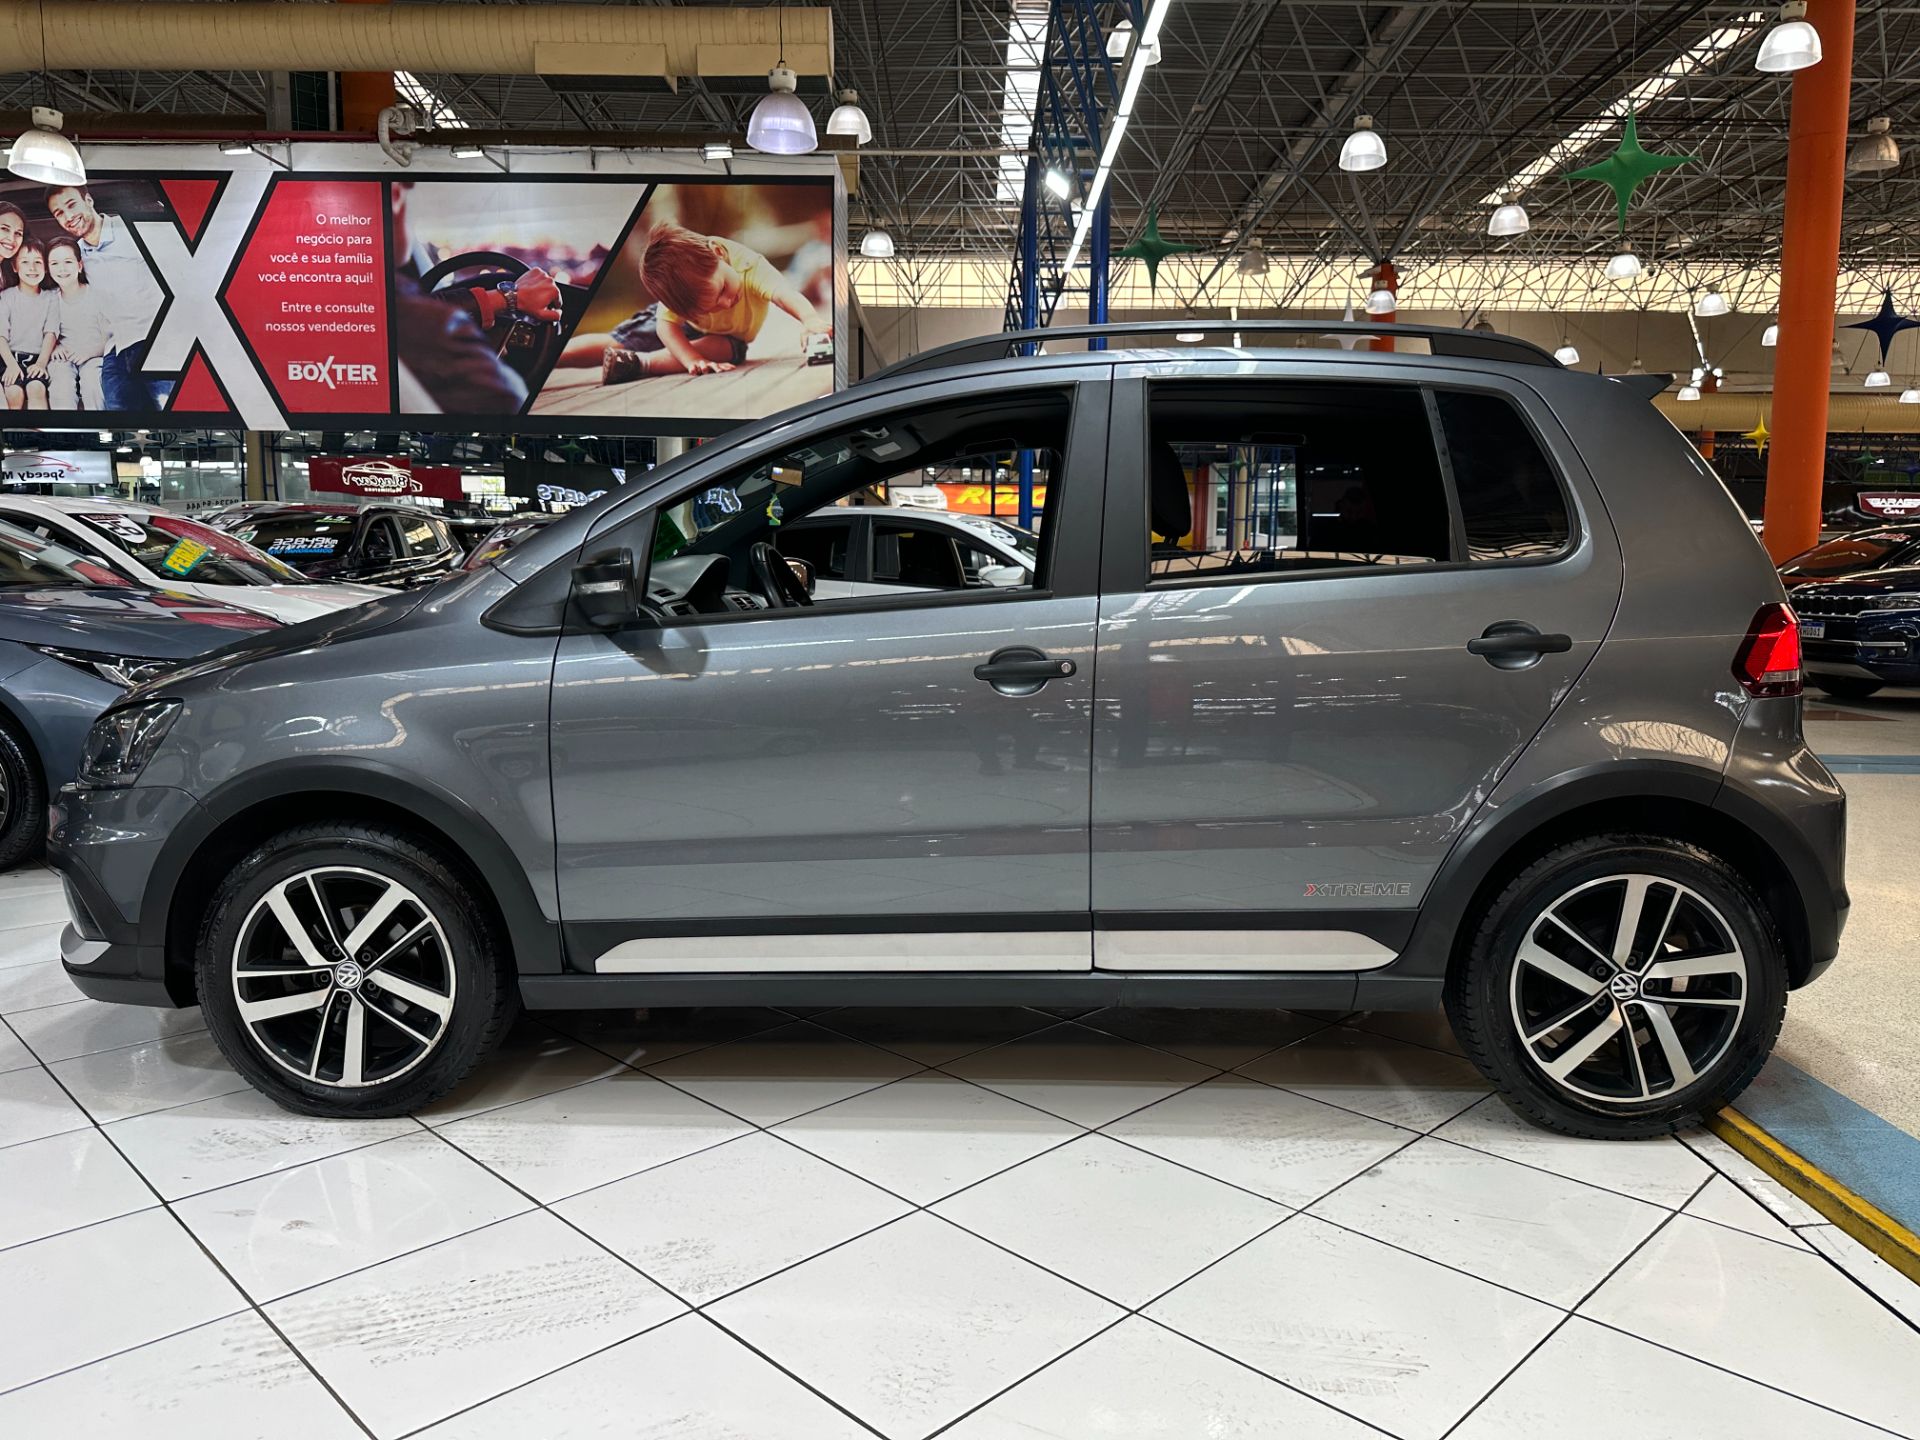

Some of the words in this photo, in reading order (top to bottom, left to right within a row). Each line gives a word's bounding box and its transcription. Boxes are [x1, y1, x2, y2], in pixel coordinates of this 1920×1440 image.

[316, 213, 327, 225] O
[330, 214, 372, 225] melhor
[296, 233, 344, 247] negócio
[347, 235, 373, 247] para
[270, 252, 298, 263] você
[301, 255, 309, 263] e
[311, 255, 331, 264] sua
[334, 252, 373, 264] família
[258, 271, 286, 282] você
[289, 273, 342, 283] encontra
[345, 273, 374, 285] aqui!
[281, 301, 312, 313] Entre
[314, 305, 322, 313] e
[325, 302, 375, 313] consulte
[265, 322, 306, 332] nossos
[308, 321, 376, 332] vendedores
[287, 355, 378, 389] BOXTER
[1303, 882, 1411, 897] XTREME
